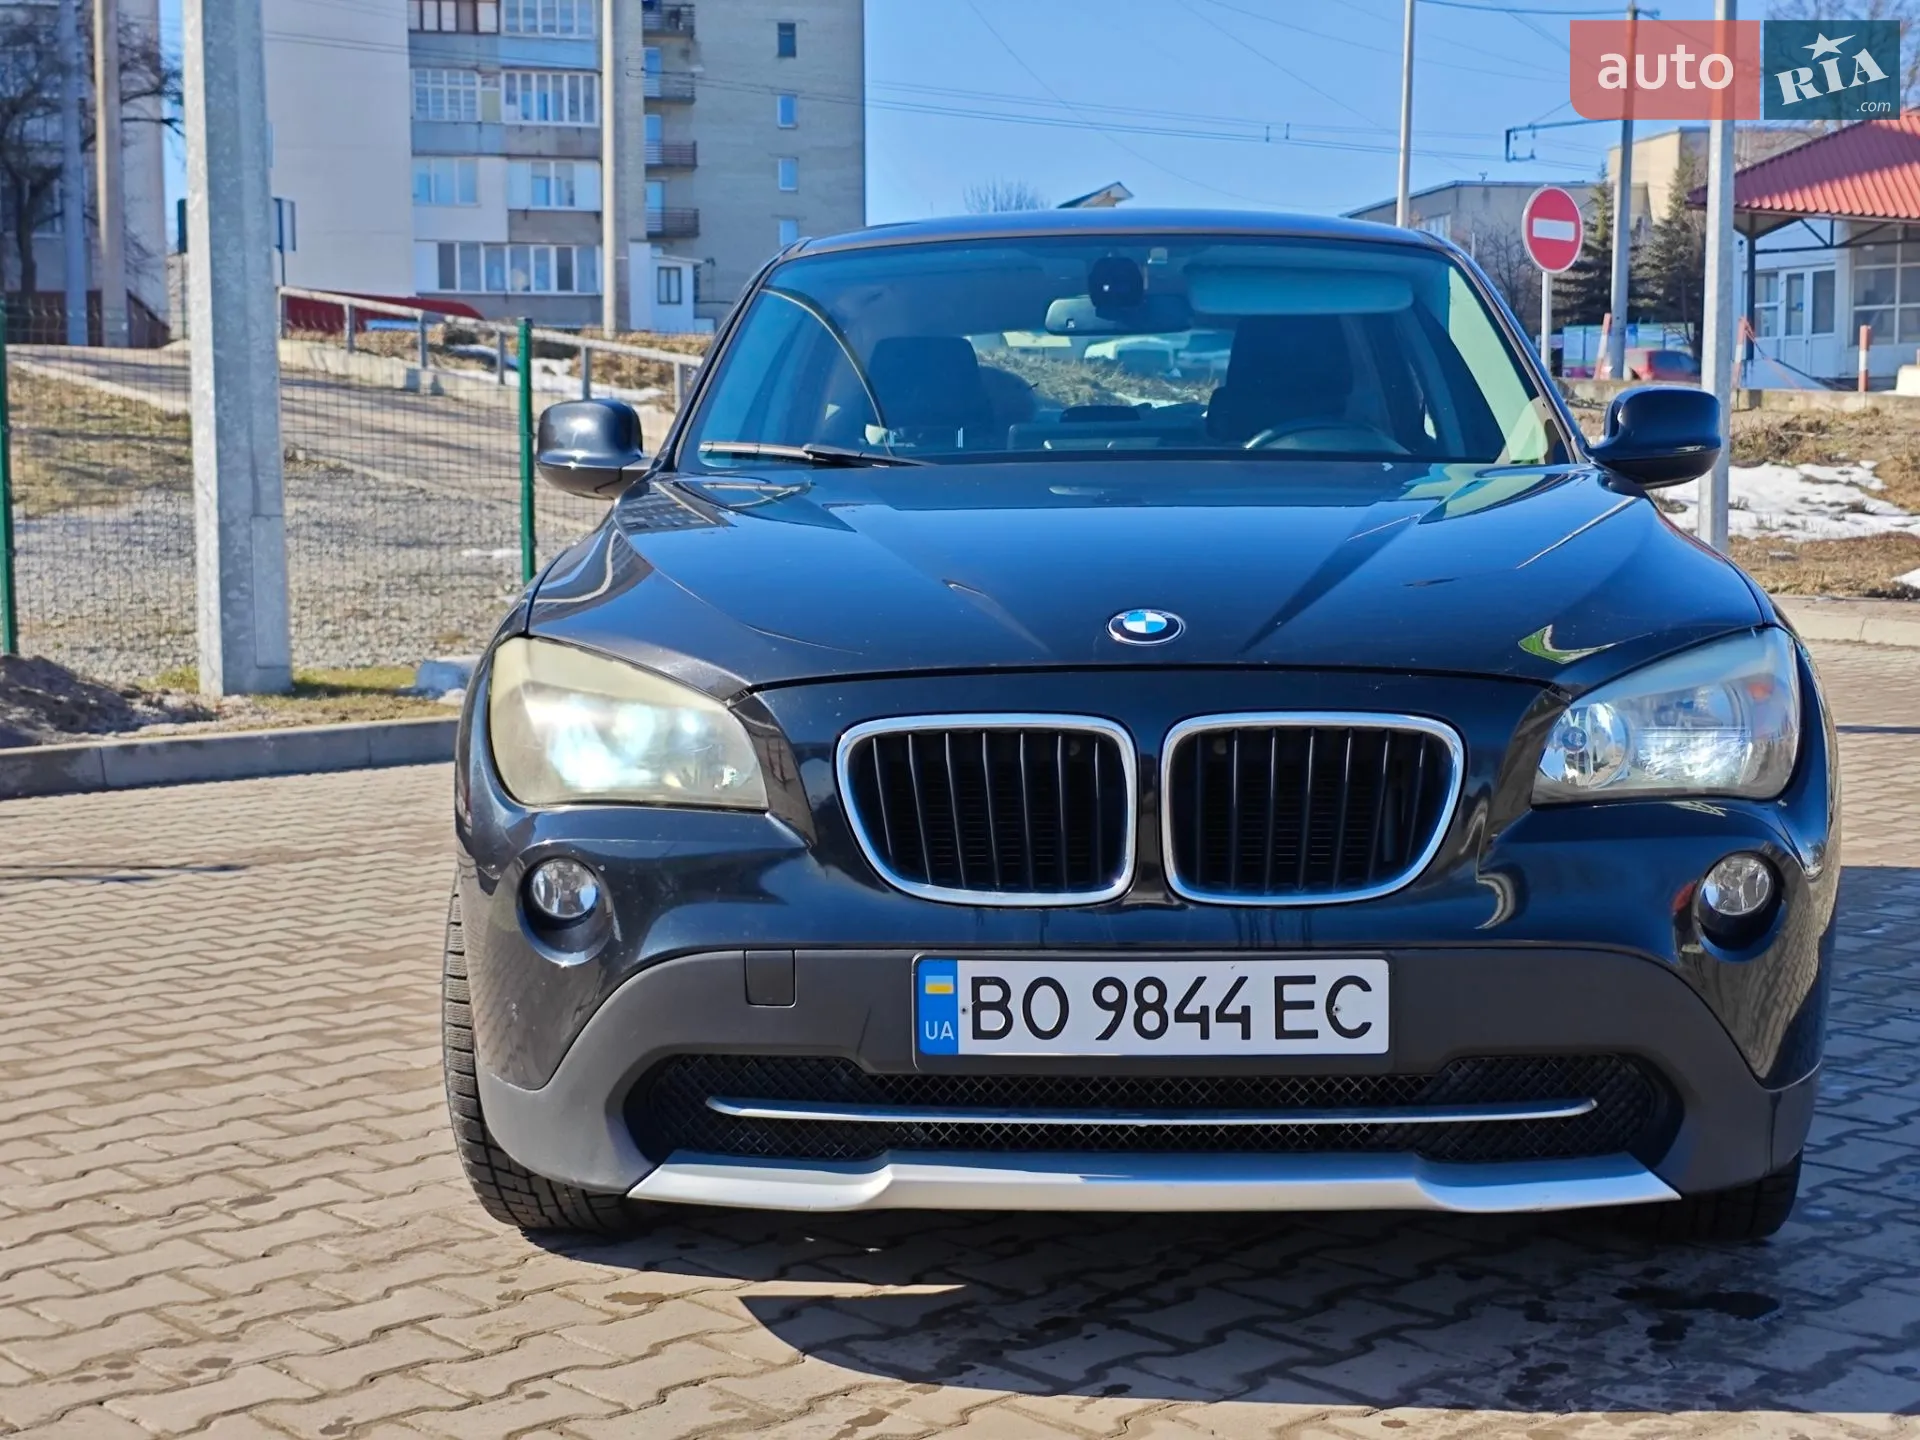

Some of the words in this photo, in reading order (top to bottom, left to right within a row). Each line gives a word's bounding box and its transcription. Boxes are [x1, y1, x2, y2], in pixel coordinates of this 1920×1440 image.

[970, 976, 1070, 1041] BO
[1092, 976, 1251, 1041] 9844
[1274, 975, 1373, 1040] EC
[925, 1020, 955, 1041] UA
